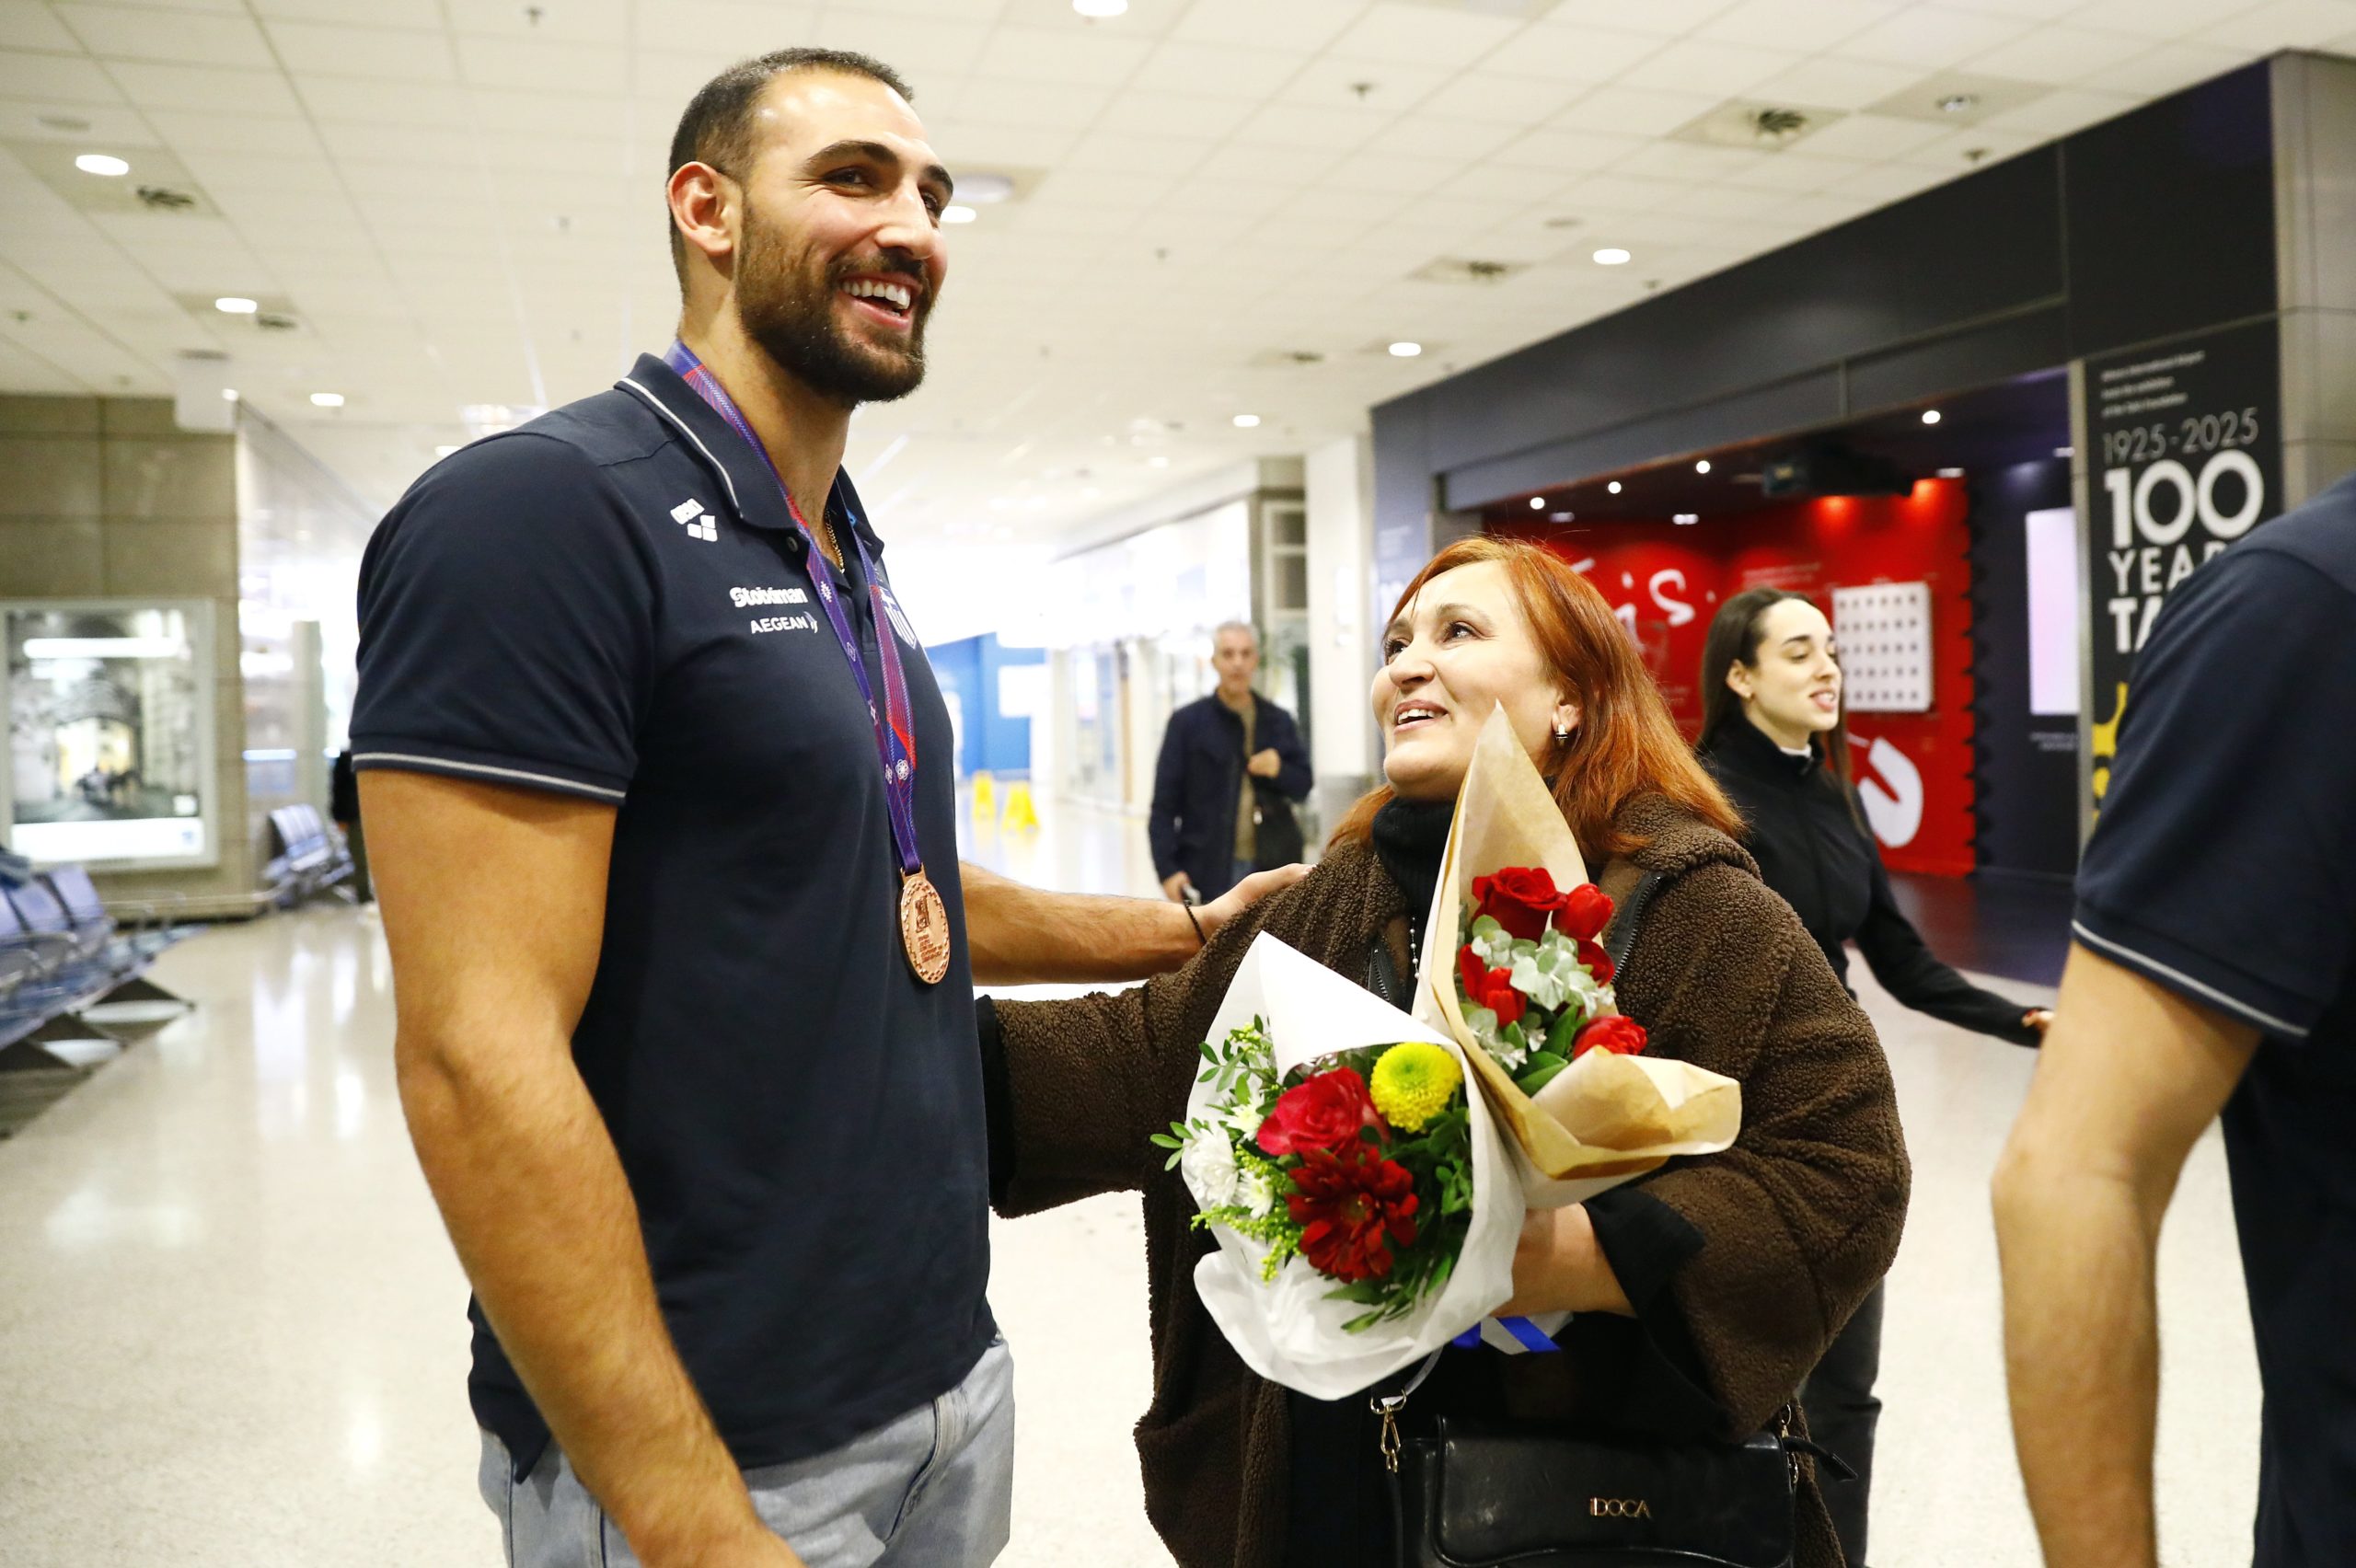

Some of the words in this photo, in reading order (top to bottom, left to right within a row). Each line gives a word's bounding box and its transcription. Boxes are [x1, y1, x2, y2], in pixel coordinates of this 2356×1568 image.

[2104, 448, 2264, 549] 100
[729, 586, 809, 608] Stoiximan
[750, 616, 810, 635] AEGEAN
